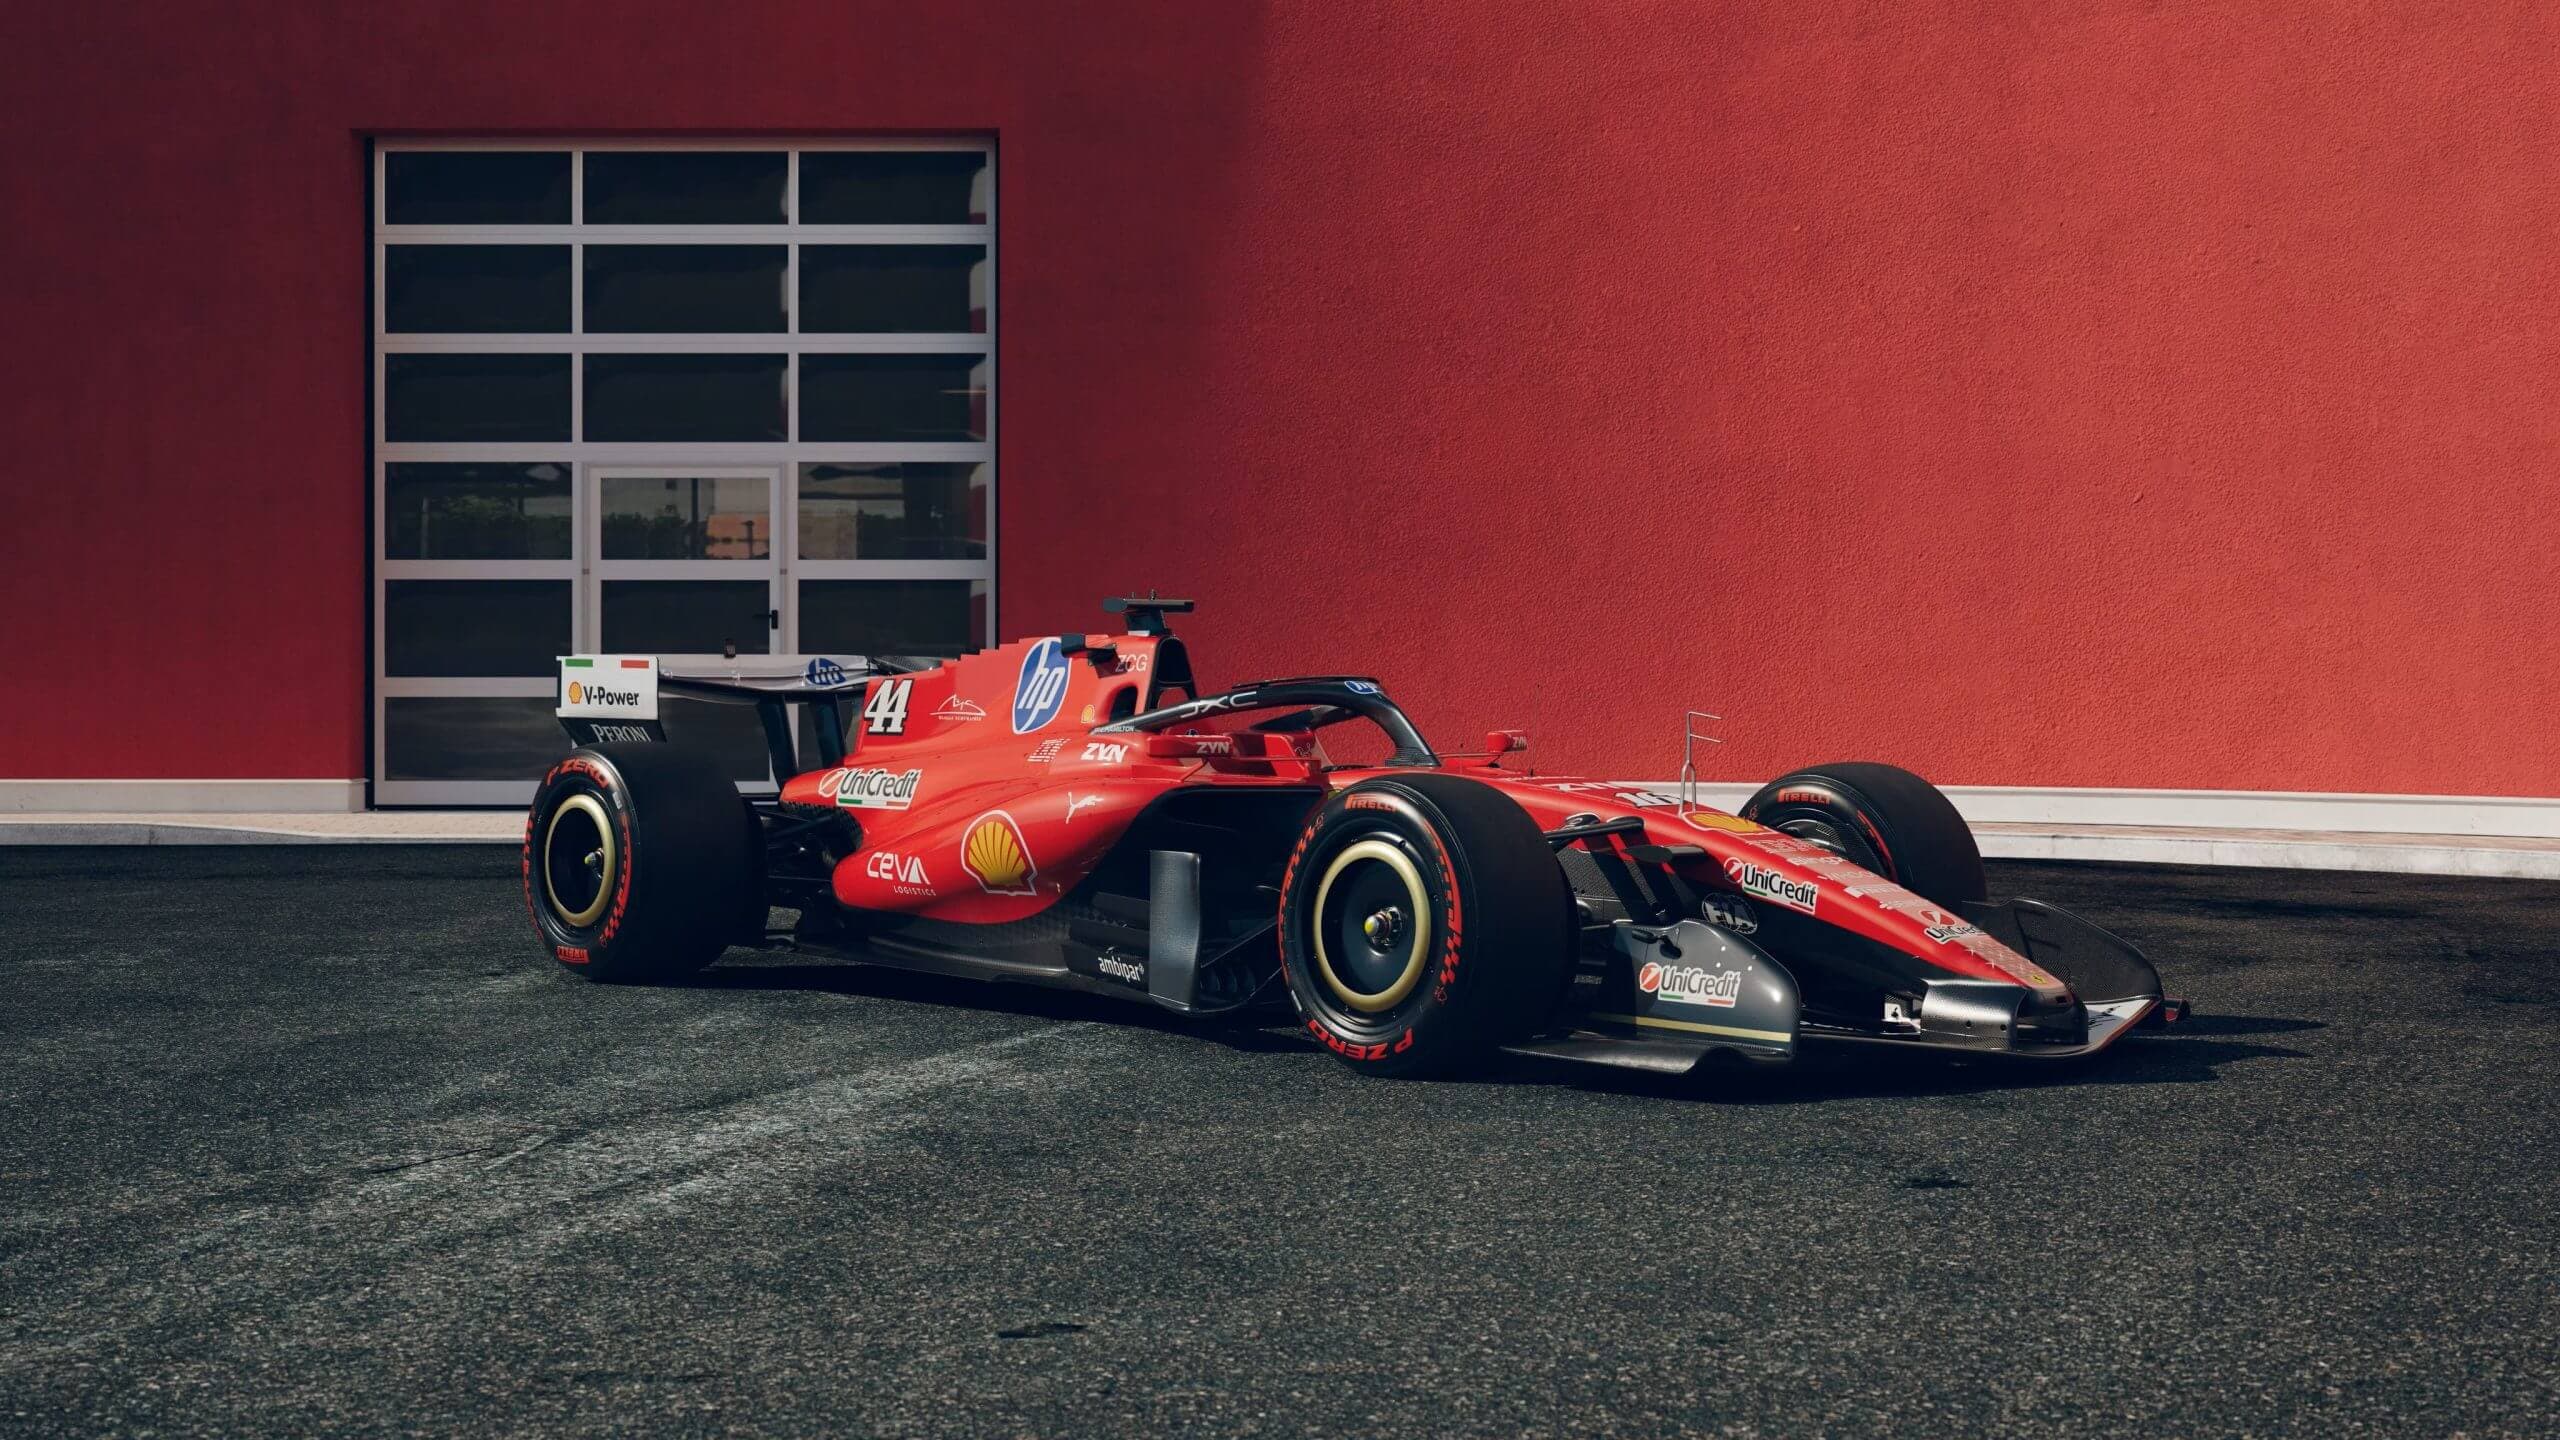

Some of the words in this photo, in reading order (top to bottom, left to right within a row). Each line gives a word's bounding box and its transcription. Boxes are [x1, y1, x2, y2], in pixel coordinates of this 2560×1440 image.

[1115, 654, 1148, 673] ZCG
[583, 686, 639, 706] V-Power
[1017, 640, 1066, 732] hp
[864, 679, 913, 733] 44
[590, 724, 652, 743] PERONI
[1080, 742, 1128, 763] ZYN
[1197, 742, 1230, 755] ZYN
[840, 770, 918, 799] UniCredit
[1777, 788, 1832, 805] PIRELLI
[894, 885, 937, 897] LOGISTICS
[1743, 863, 1817, 907] UniCredit
[1661, 966, 1739, 998] UniCredit
[1308, 1019, 1389, 1061] ZERO
[1394, 1027, 1415, 1054] P
